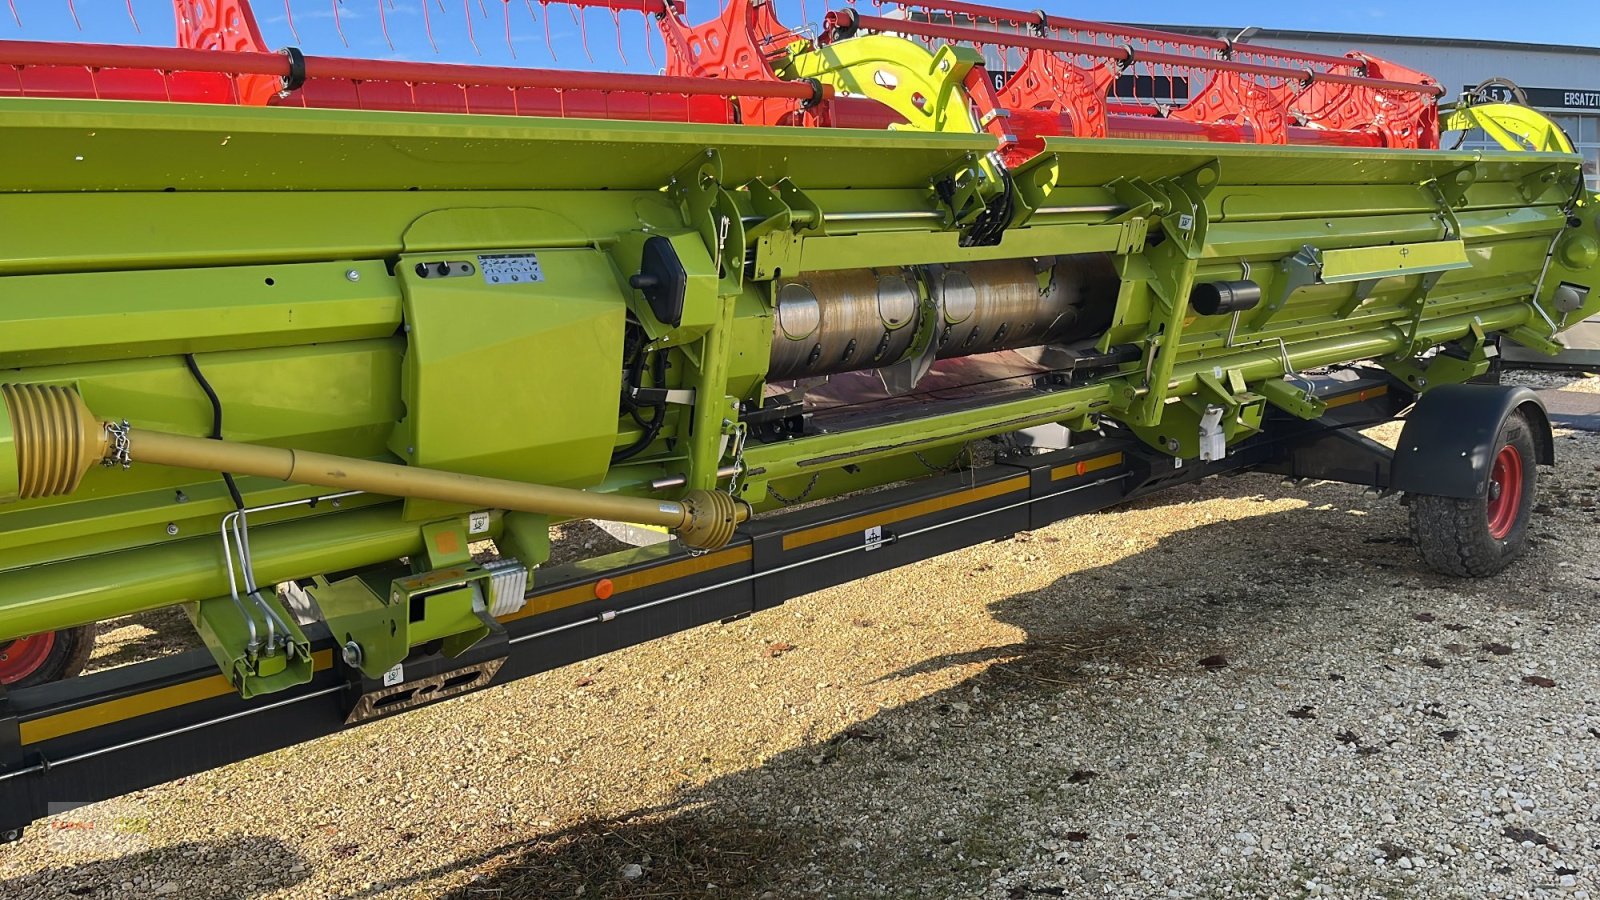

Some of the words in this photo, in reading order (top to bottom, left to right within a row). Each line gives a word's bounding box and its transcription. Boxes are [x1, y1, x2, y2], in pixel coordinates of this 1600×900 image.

[995, 74, 1003, 90] 6
[1491, 89, 1498, 101] 5
[1564, 92, 1600, 106] ERSATZT
